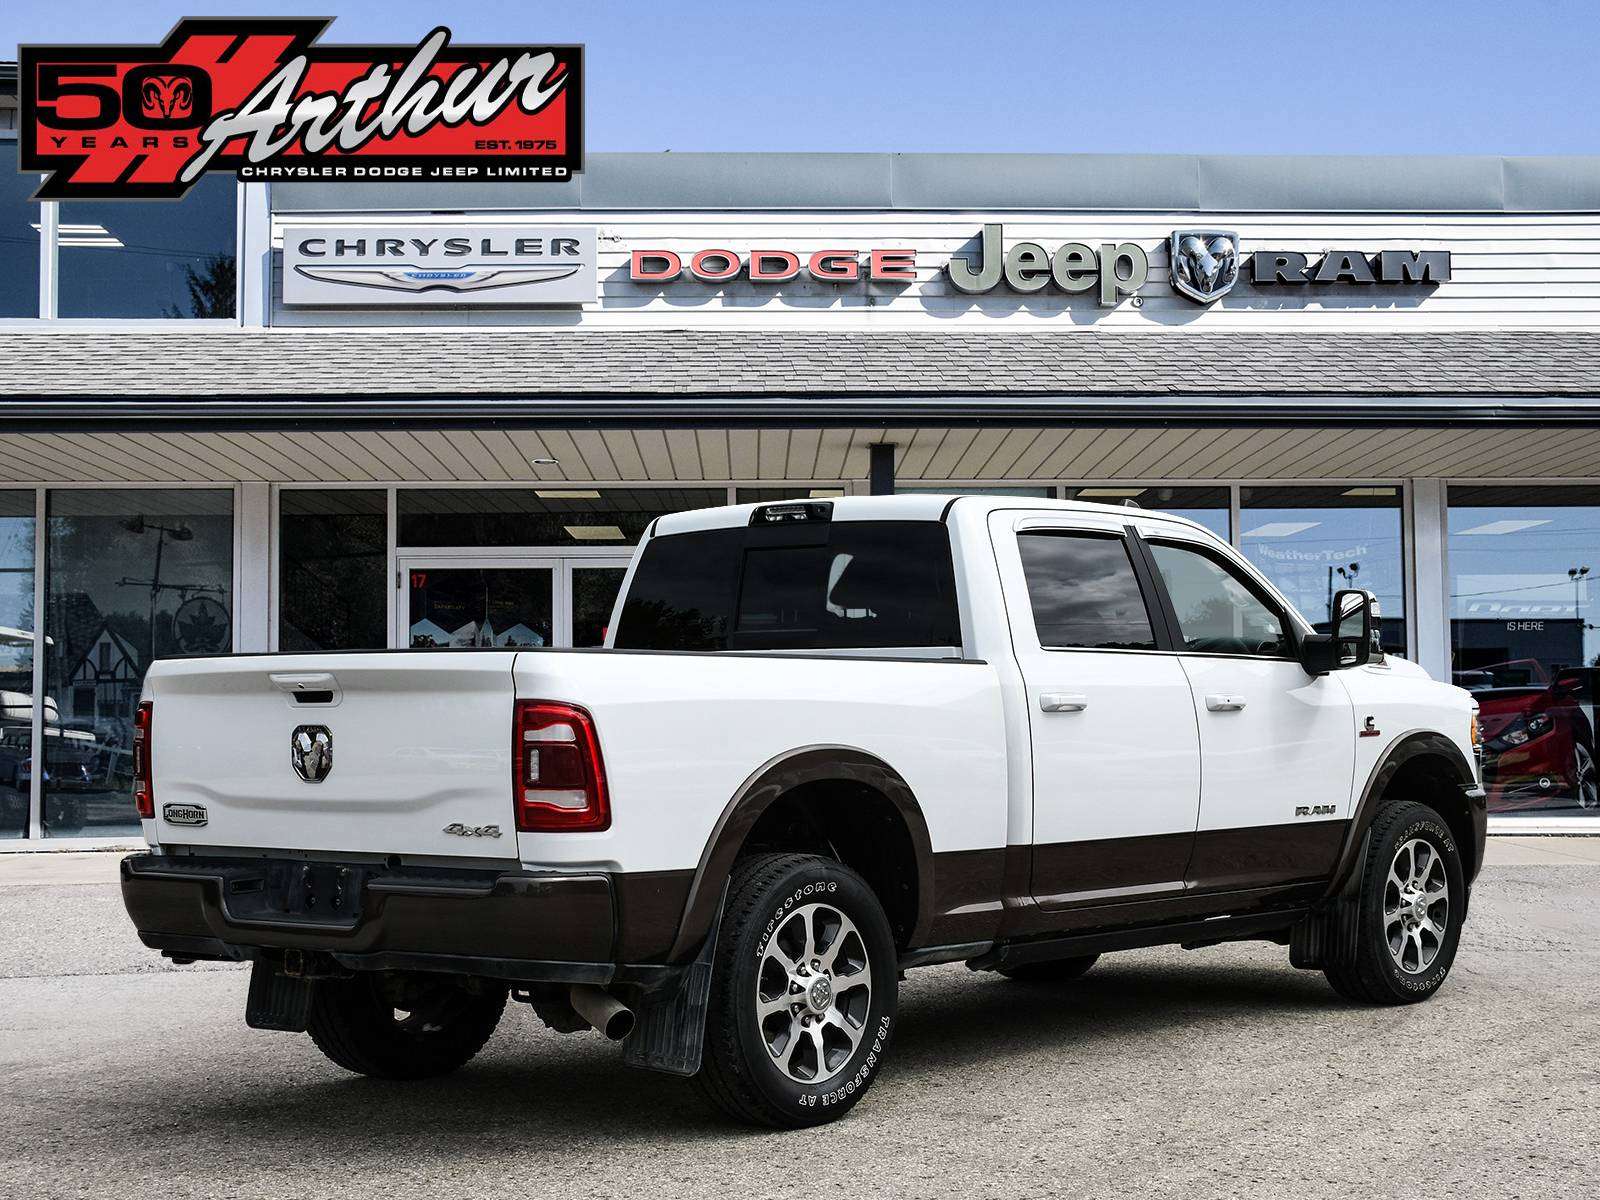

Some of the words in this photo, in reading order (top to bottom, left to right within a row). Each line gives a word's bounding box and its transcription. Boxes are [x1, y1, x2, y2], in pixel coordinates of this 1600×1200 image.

[297, 237, 582, 258] CHRYSLER
[629, 248, 917, 283] DODGE
[948, 223, 1149, 306] Jeep
[1251, 250, 1452, 286] RAM
[412, 574, 427, 588] 17
[1506, 621, 1516, 631] IS
[1518, 621, 1544, 631] HERE
[1295, 805, 1336, 816] RAM
[822, 1016, 891, 1106] TRANSFORCE
[799, 1094, 815, 1107] AT
